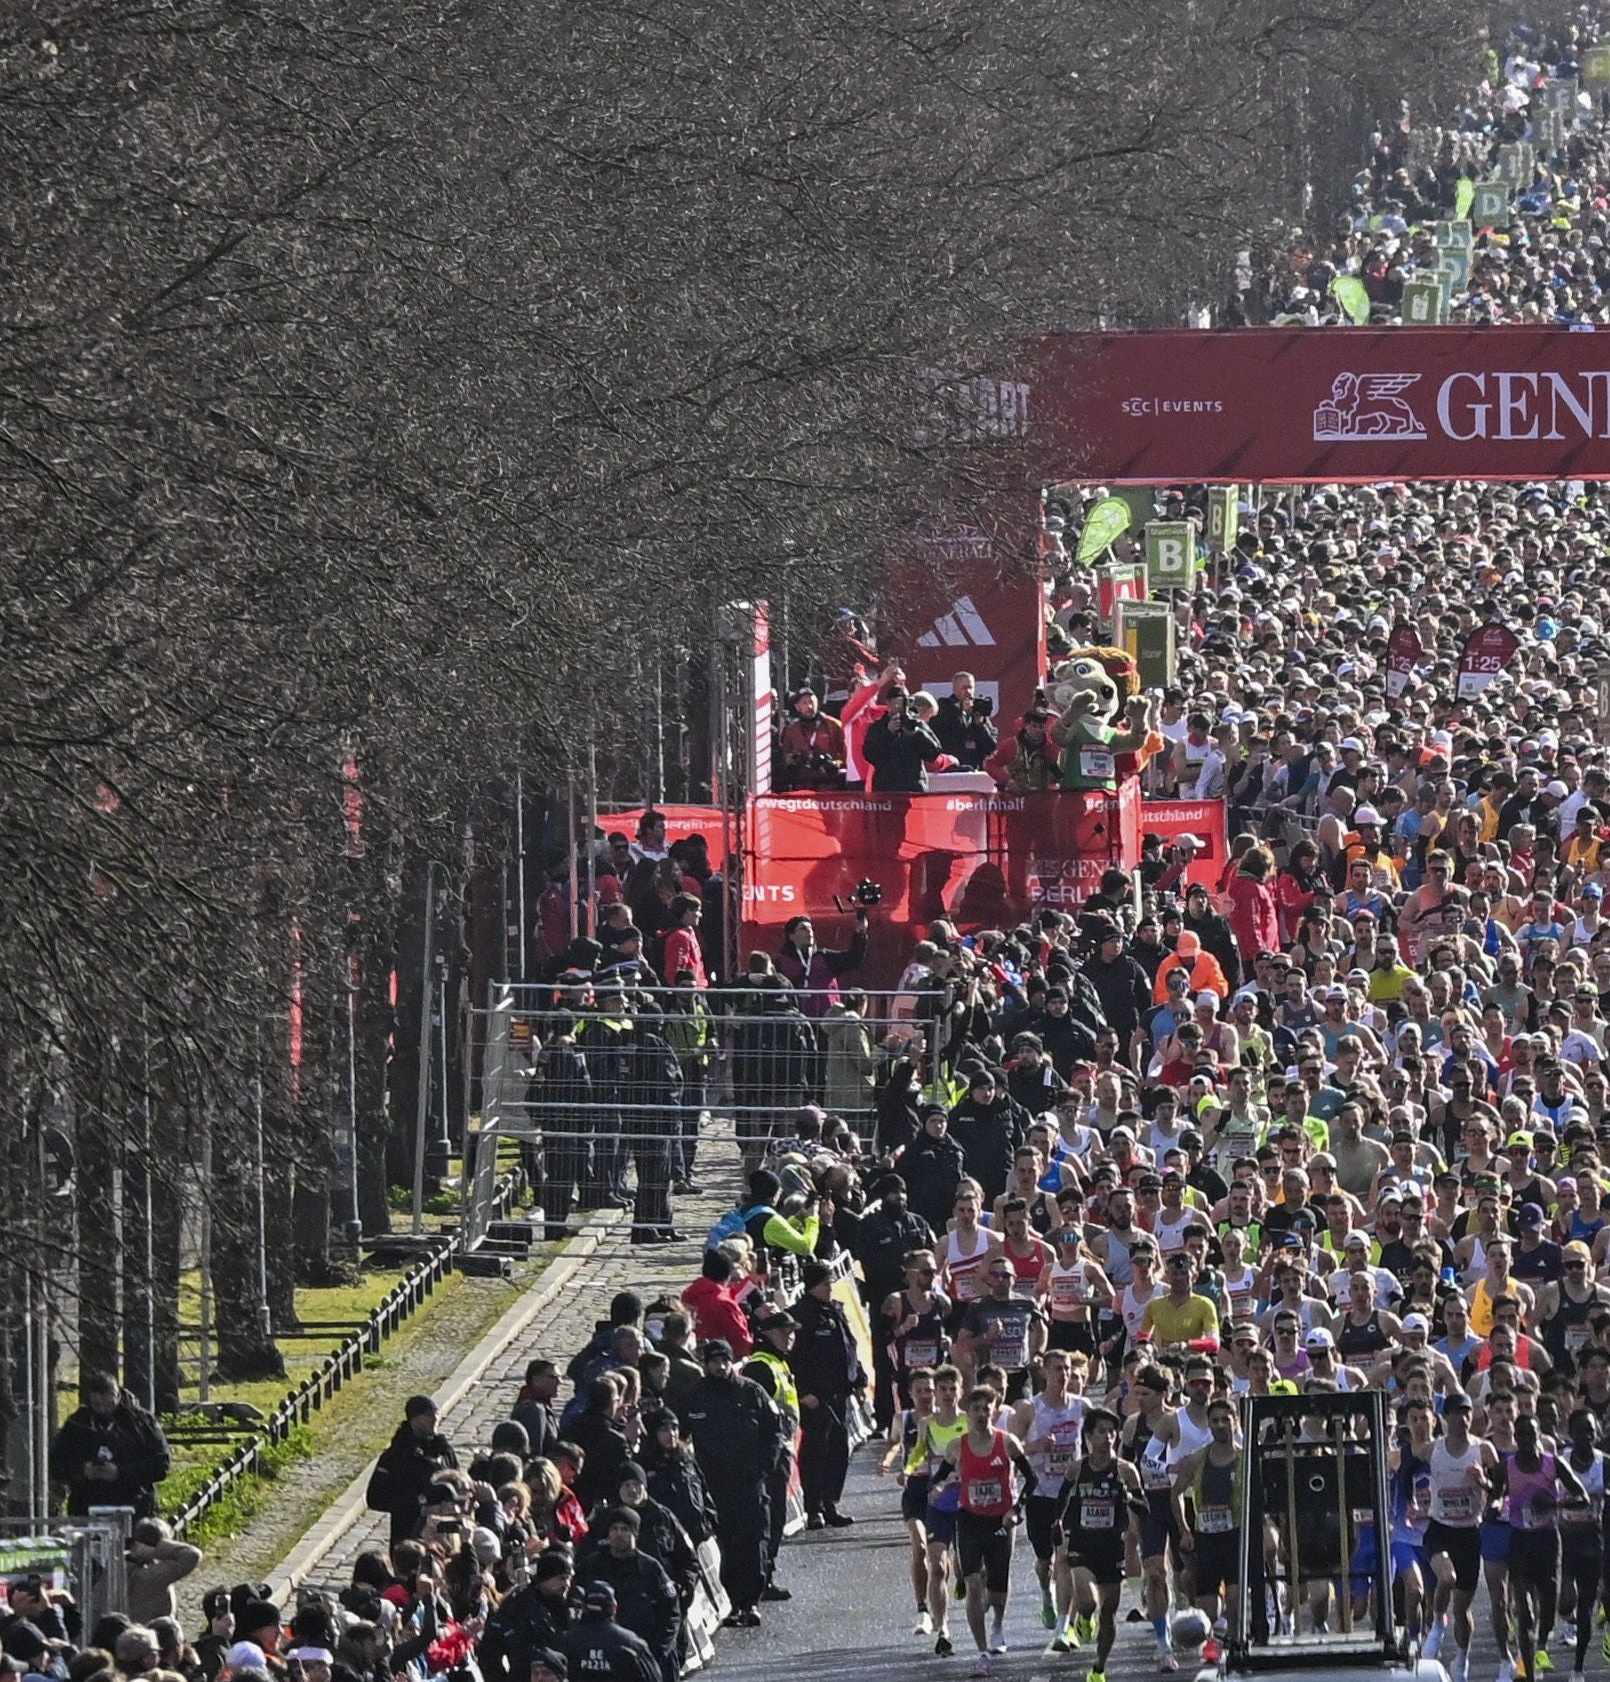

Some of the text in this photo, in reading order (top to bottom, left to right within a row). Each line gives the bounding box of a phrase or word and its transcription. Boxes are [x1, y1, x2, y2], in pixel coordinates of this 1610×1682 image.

[1482, 194, 1500, 215] D
[1121, 399, 1222, 415] SCC EVENTS
[1212, 505, 1224, 535] B
[1158, 540, 1182, 571] B
[1389, 654, 1412, 672] 1:25
[1465, 656, 1501, 672] 1:25
[946, 797, 1025, 812] #berlinhalf
